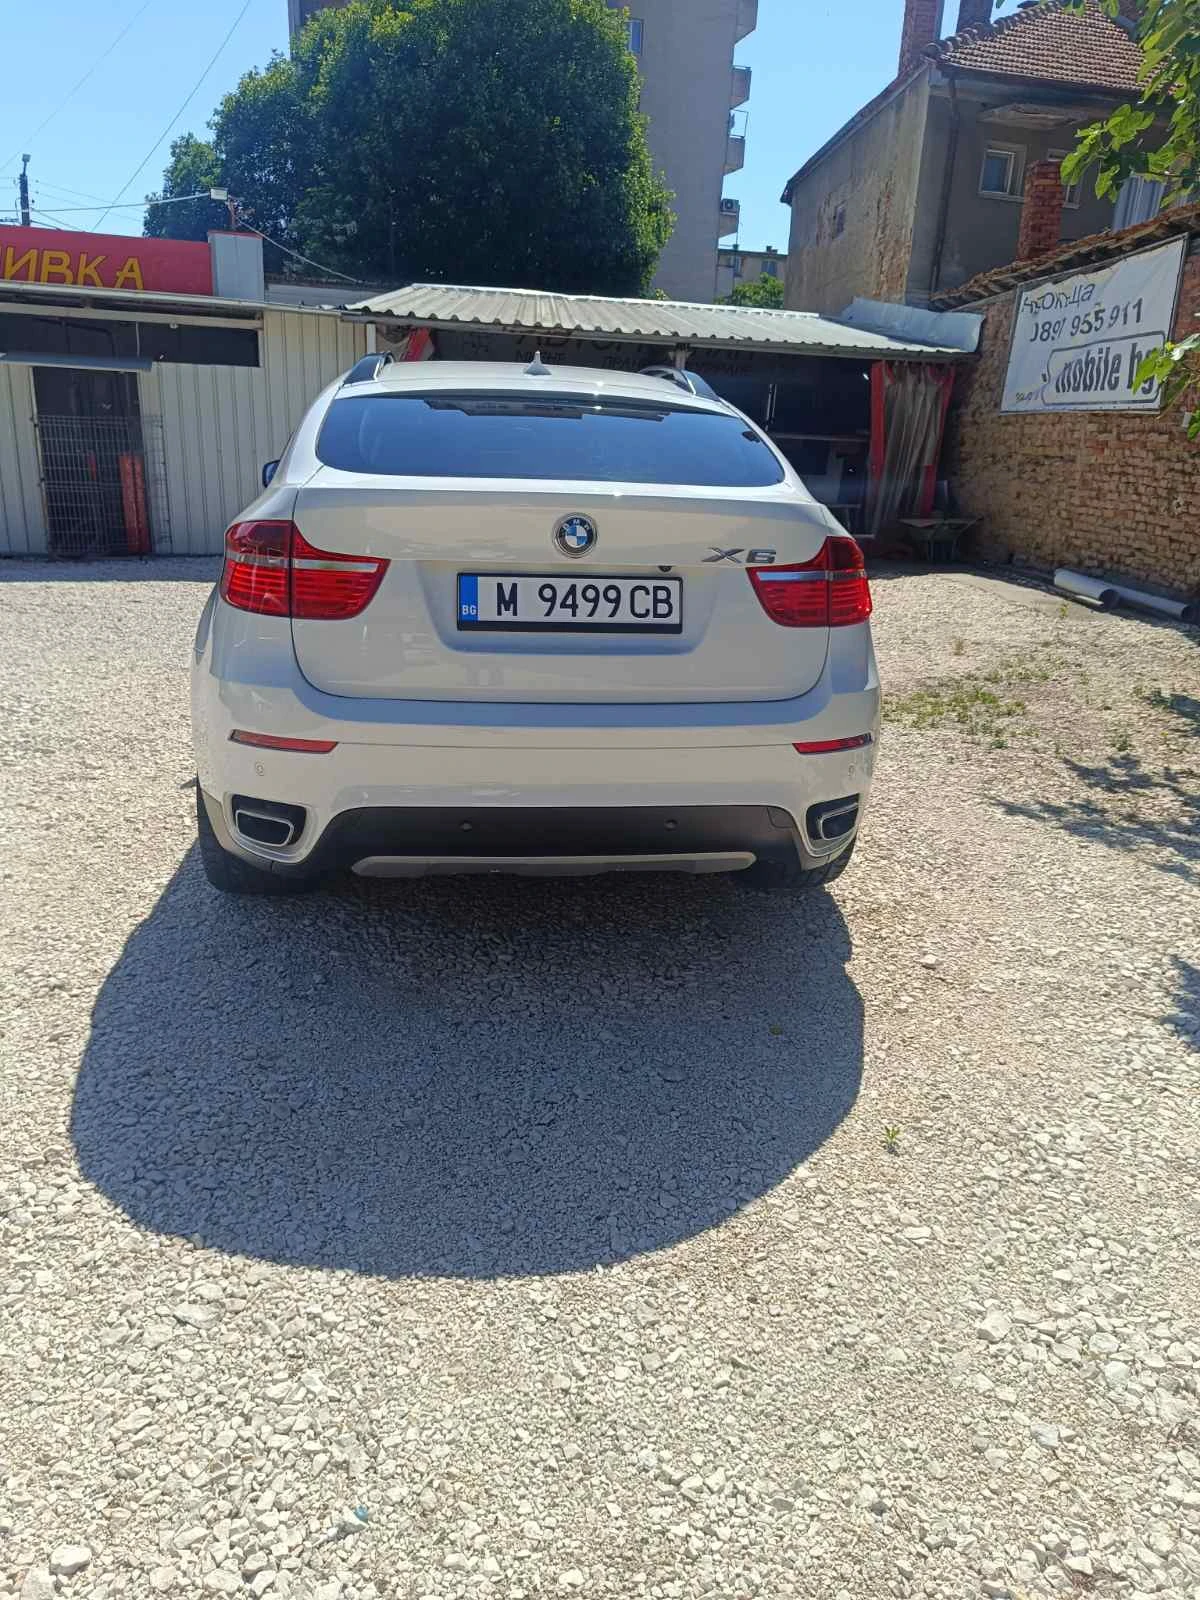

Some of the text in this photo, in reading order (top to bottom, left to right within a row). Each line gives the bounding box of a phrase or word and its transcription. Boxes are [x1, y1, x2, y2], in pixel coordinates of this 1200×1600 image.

[0, 246, 145, 290] ИВКА
[701, 547, 777, 564] X6
[461, 604, 477, 616] BG
[496, 582, 674, 619] M 9499 CB
